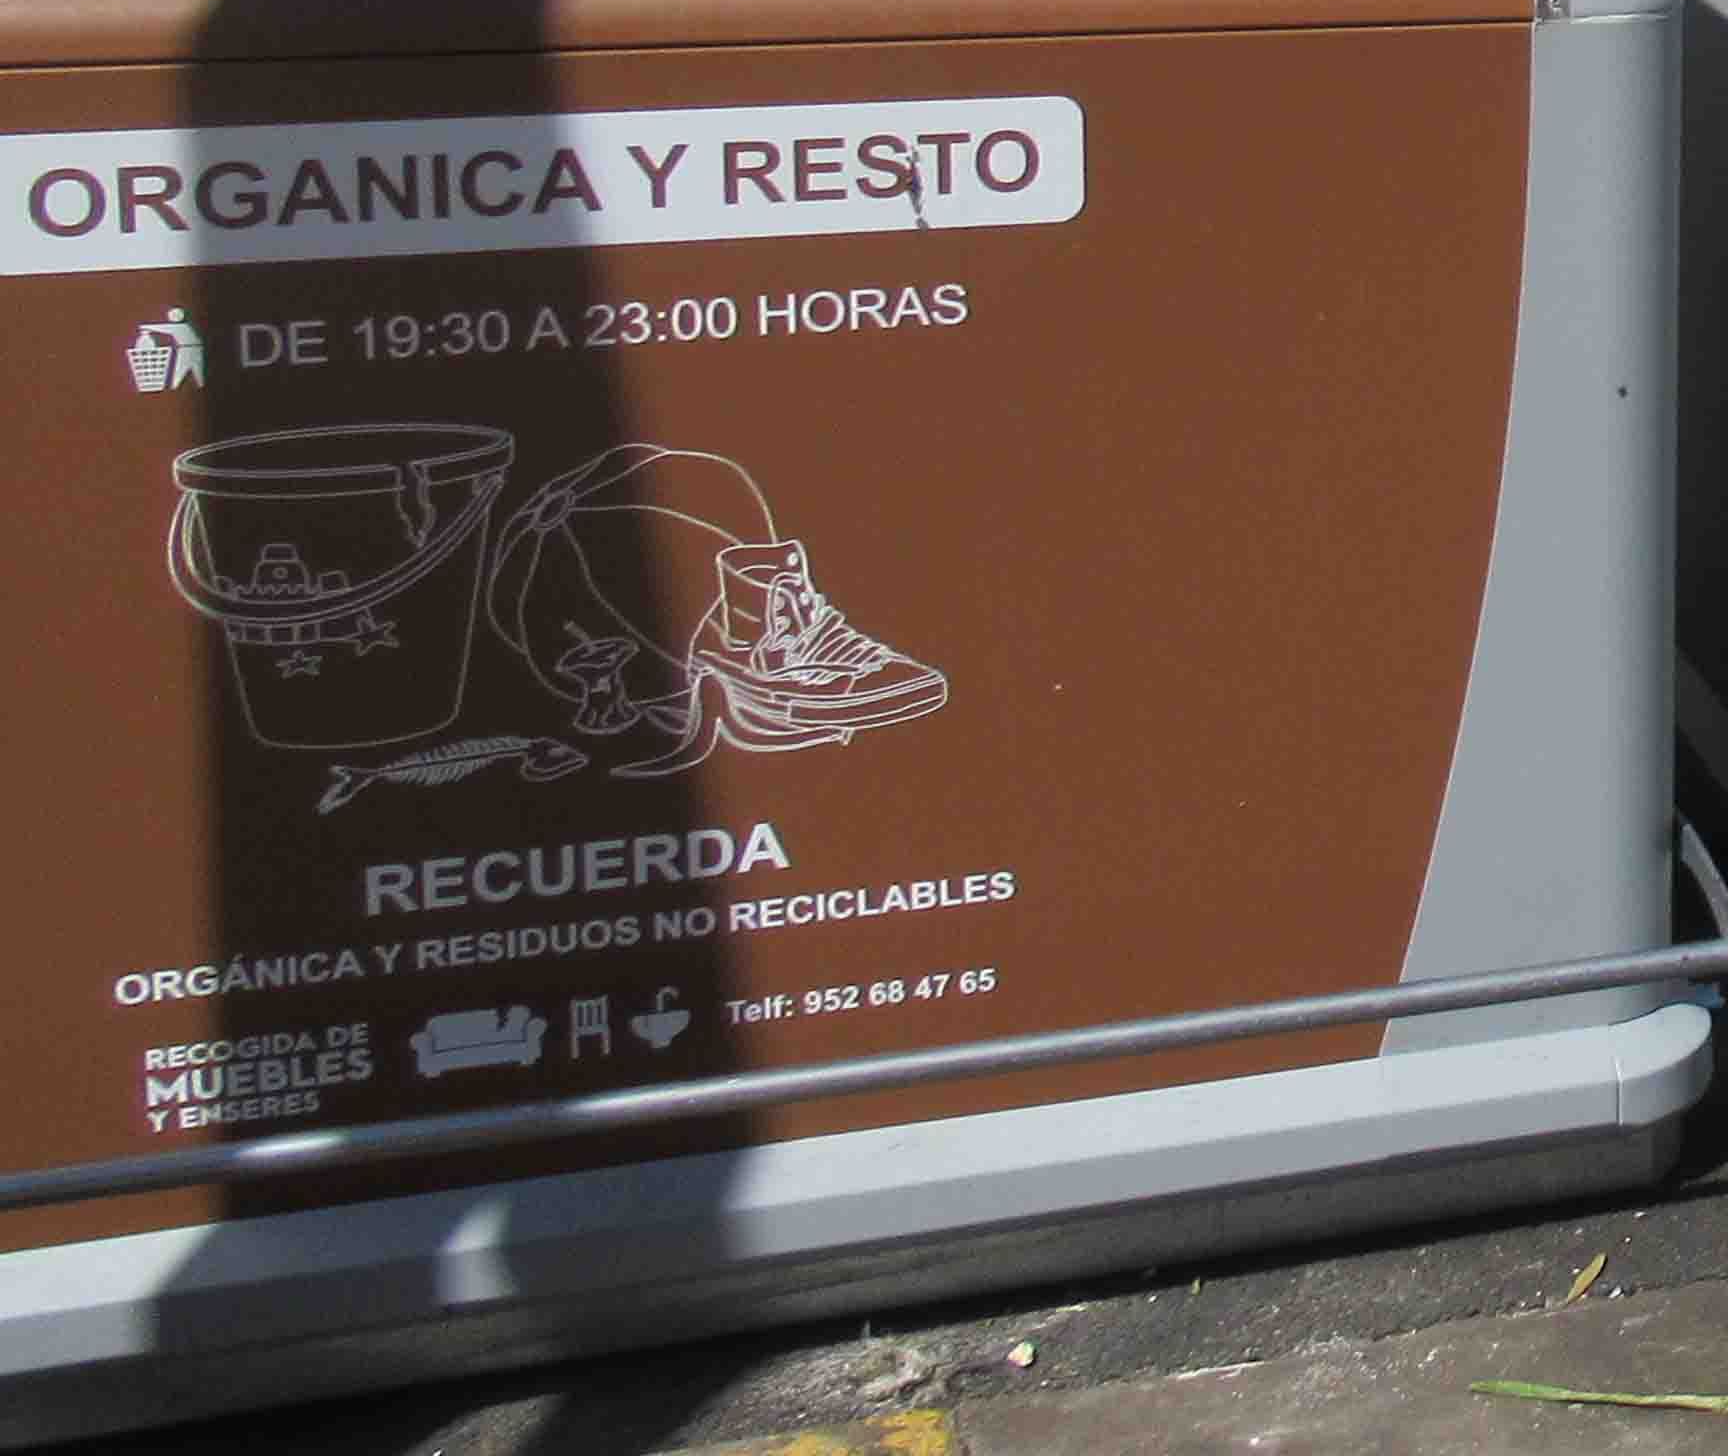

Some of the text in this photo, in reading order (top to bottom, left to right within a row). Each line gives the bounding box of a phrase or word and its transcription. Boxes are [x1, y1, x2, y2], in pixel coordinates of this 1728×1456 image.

[28, 129, 1041, 238] ORGANICA Y RESTO
[239, 282, 970, 369] DE 19:30 A 23:00 HORAS
[366, 822, 791, 916] RECUERDA
[113, 870, 1016, 1007] ORGÁNICA Y RESIDUOS NO RECICLABLES
[727, 967, 996, 1026] Telf: 952 68 47 65
[144, 1023, 370, 1072] RECOGIDA DE
[145, 1048, 374, 1108] MUEBLES
[147, 1090, 321, 1134] Y ENSERES
